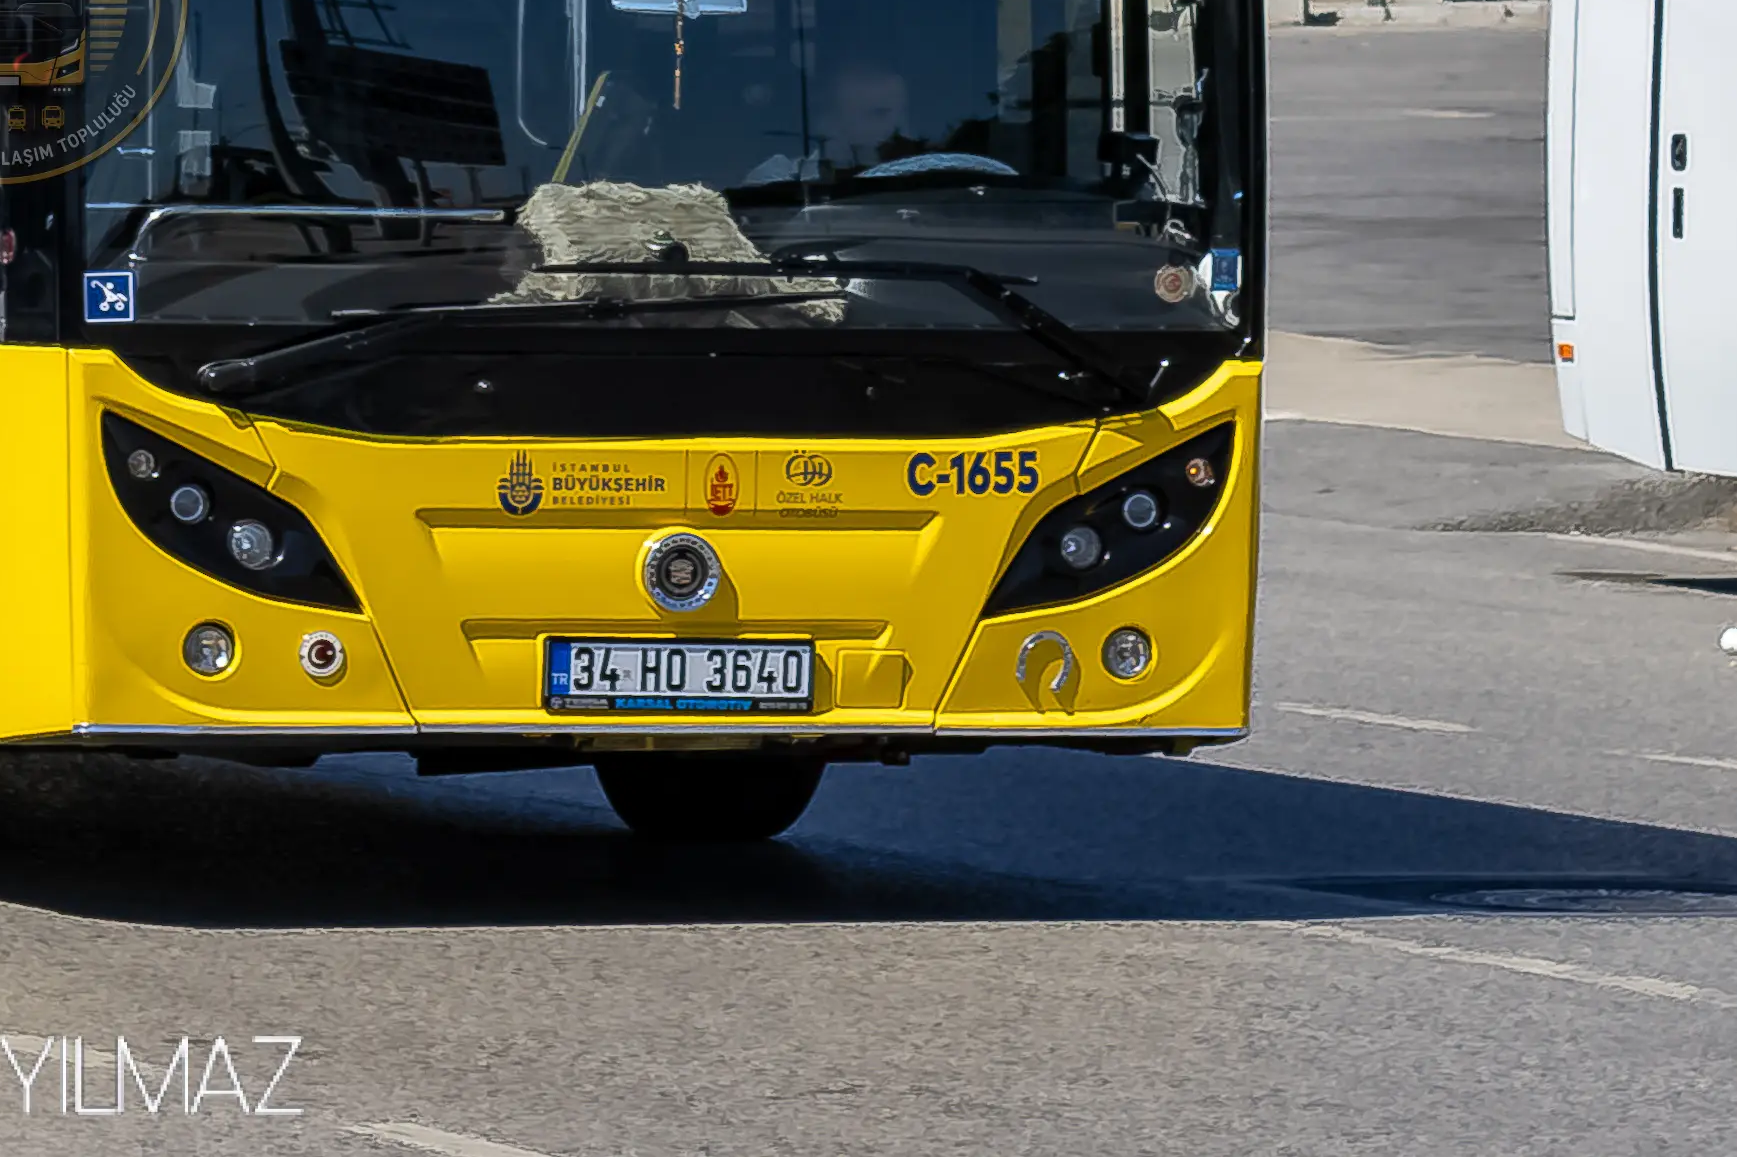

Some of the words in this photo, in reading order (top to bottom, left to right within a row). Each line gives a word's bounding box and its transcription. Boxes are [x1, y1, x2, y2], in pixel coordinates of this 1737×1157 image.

[552, 463, 631, 473] İSTANBUL
[907, 451, 1039, 496] C-1655
[552, 475, 666, 493] BÜYÜKŞEHİR
[552, 495, 631, 506] BELEDİYESİ
[776, 490, 806, 503] ÖZEL
[809, 493, 844, 503] HALK
[573, 647, 620, 692] 34
[706, 648, 803, 694] 3640
[551, 673, 569, 686] TR
